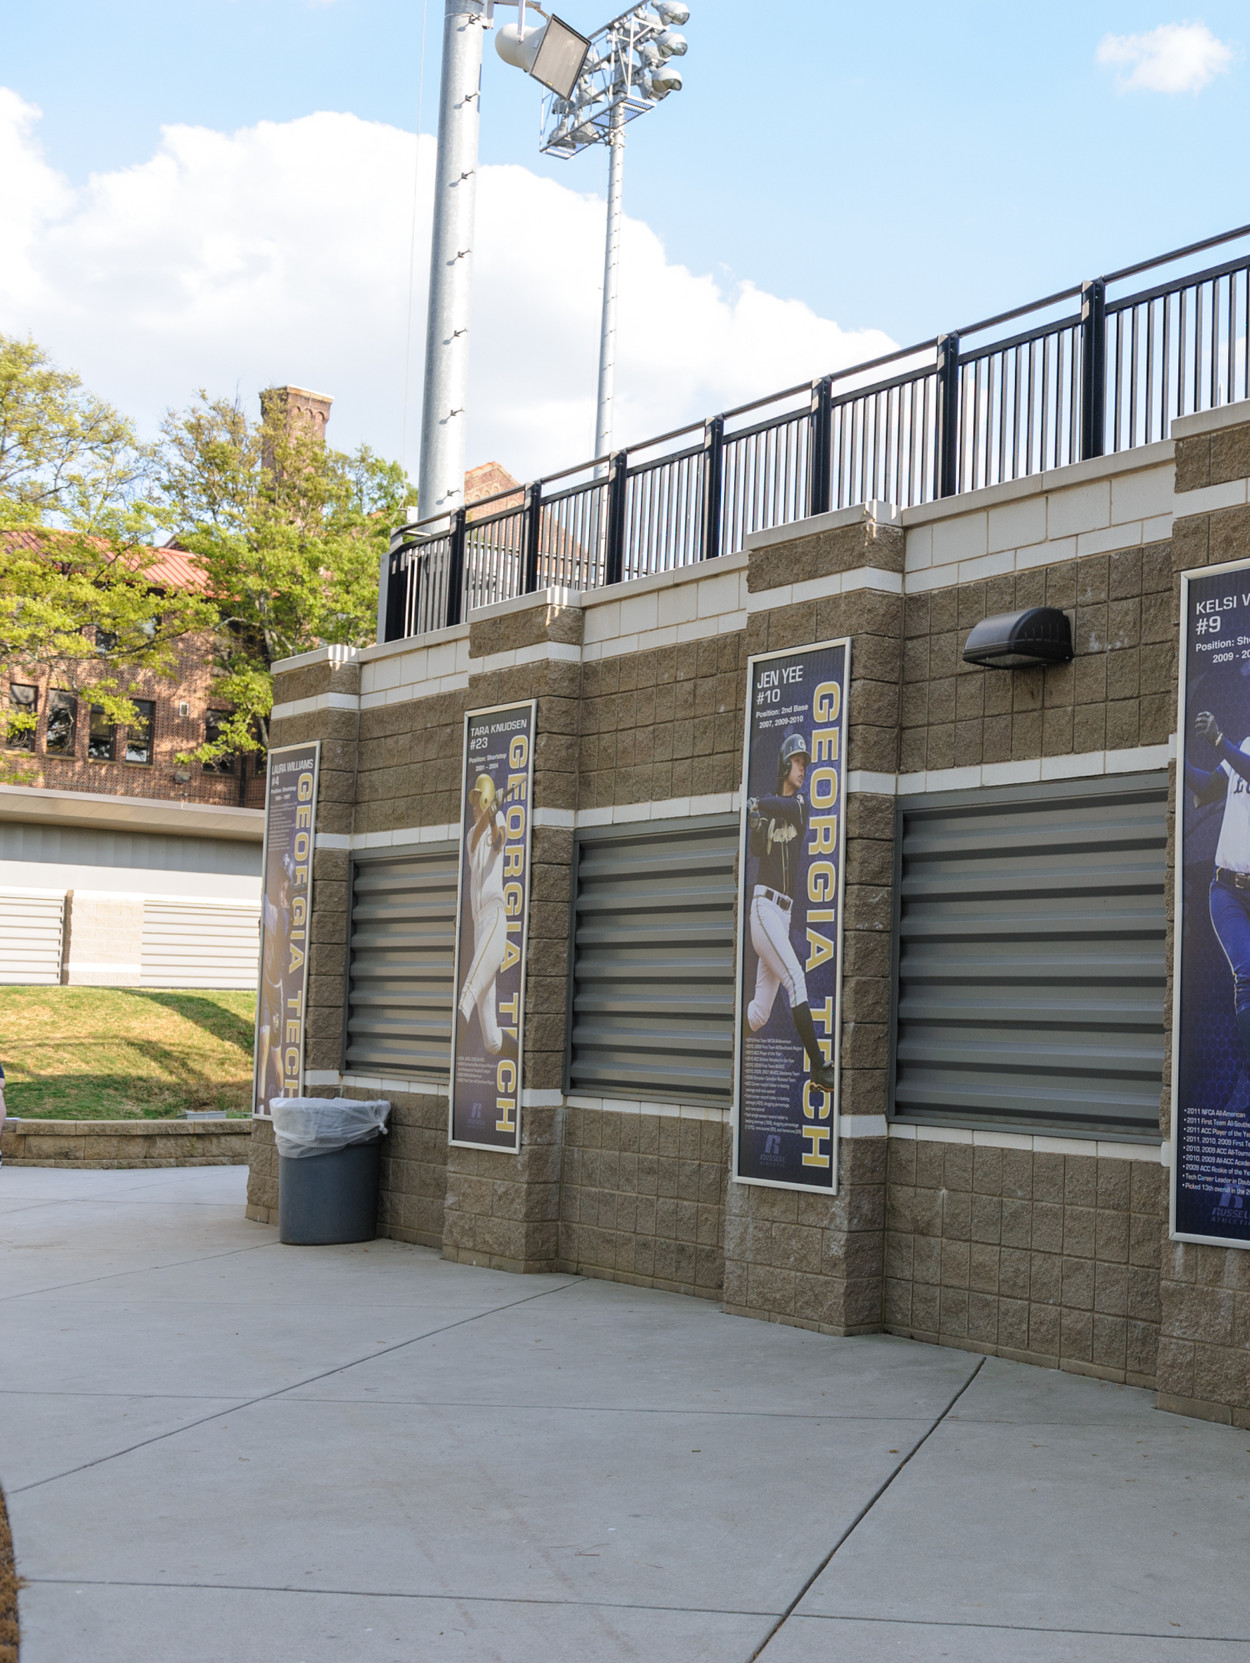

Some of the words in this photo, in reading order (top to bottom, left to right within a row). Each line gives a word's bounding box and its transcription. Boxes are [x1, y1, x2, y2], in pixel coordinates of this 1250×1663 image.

[1196, 596, 1237, 615] KELSI
[1196, 616, 1221, 635] #9
[1196, 639, 1234, 652] Position:
[1212, 653, 1234, 663] 2009
[757, 670, 779, 688] JEN
[782, 665, 803, 684] YEE
[757, 689, 780, 705] #10
[781, 706, 792, 714] 2nd
[793, 704, 808, 712] Base
[471, 726, 489, 736] TARA
[490, 719, 527, 733] KNUDSEN
[470, 737, 488, 750] #23
[806, 681, 841, 973] GEORGIA
[500, 735, 528, 973] GEORGIA
[496, 992, 519, 1132] TCH
